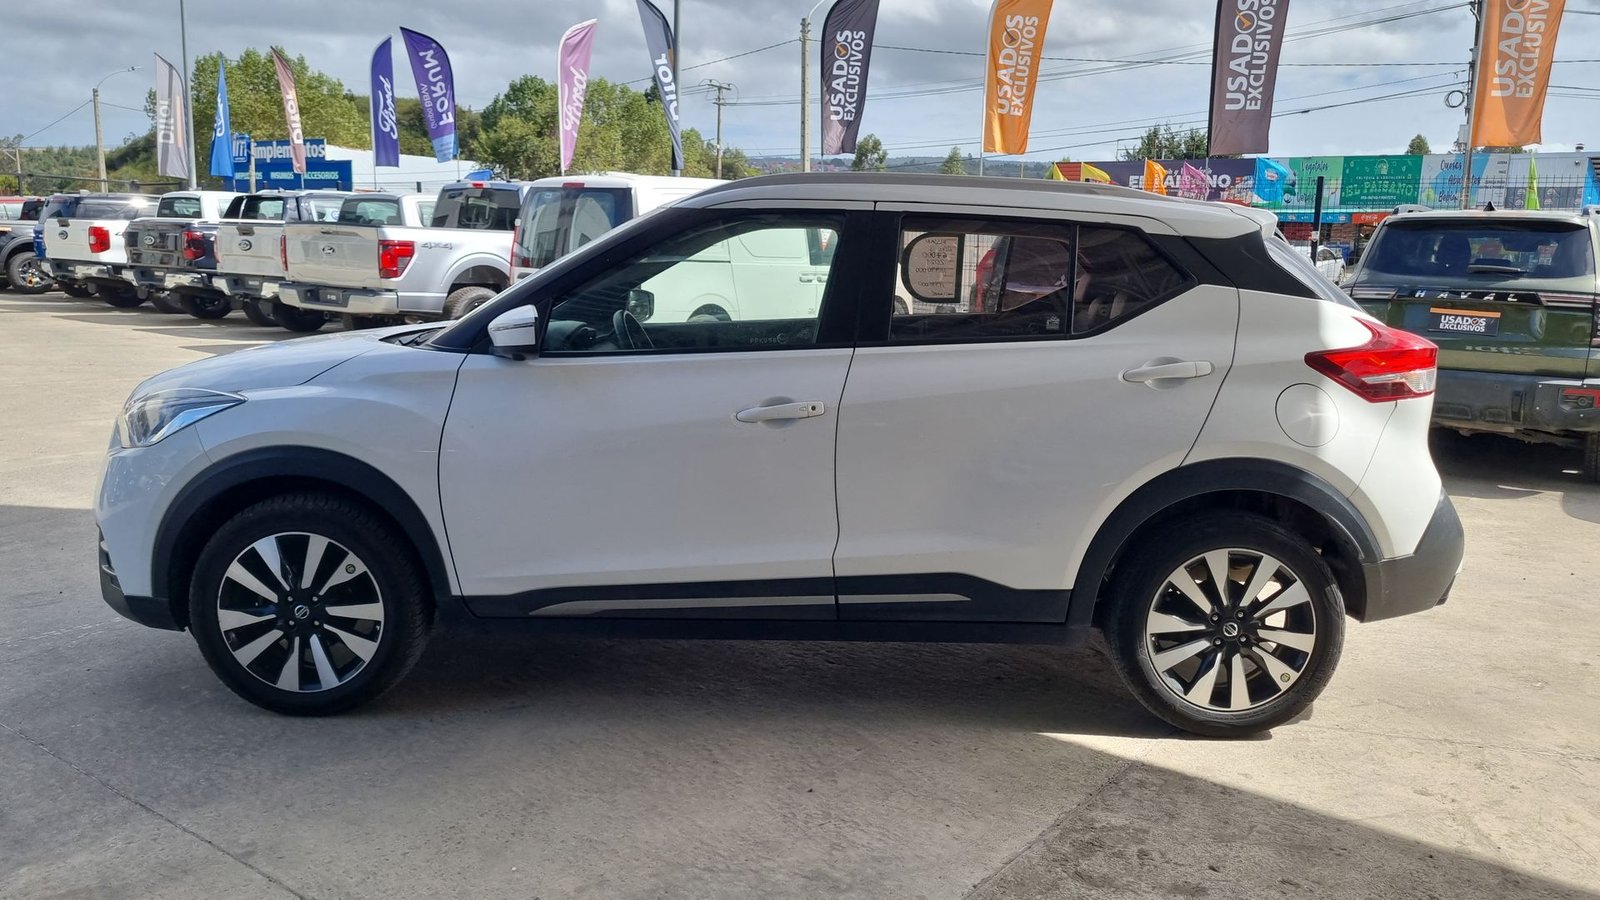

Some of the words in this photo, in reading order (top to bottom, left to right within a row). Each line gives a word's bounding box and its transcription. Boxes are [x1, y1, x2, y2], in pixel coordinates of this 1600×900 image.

[830, 29, 853, 121] USADOS
[843, 30, 866, 121] EXCLUSIVOS
[997, 14, 1025, 115] USADOS
[1010, 15, 1039, 117] EXCLUSIVOS
[1225, 0, 1259, 111] USADOS
[378, 74, 398, 140] Ford
[564, 65, 588, 137] Ford
[254, 141, 325, 163] implemtos
[1414, 289, 1518, 302] HAVAL
[1439, 322, 1485, 332] EXCLUSIVOS
[1440, 315, 1486, 326] USADOS
